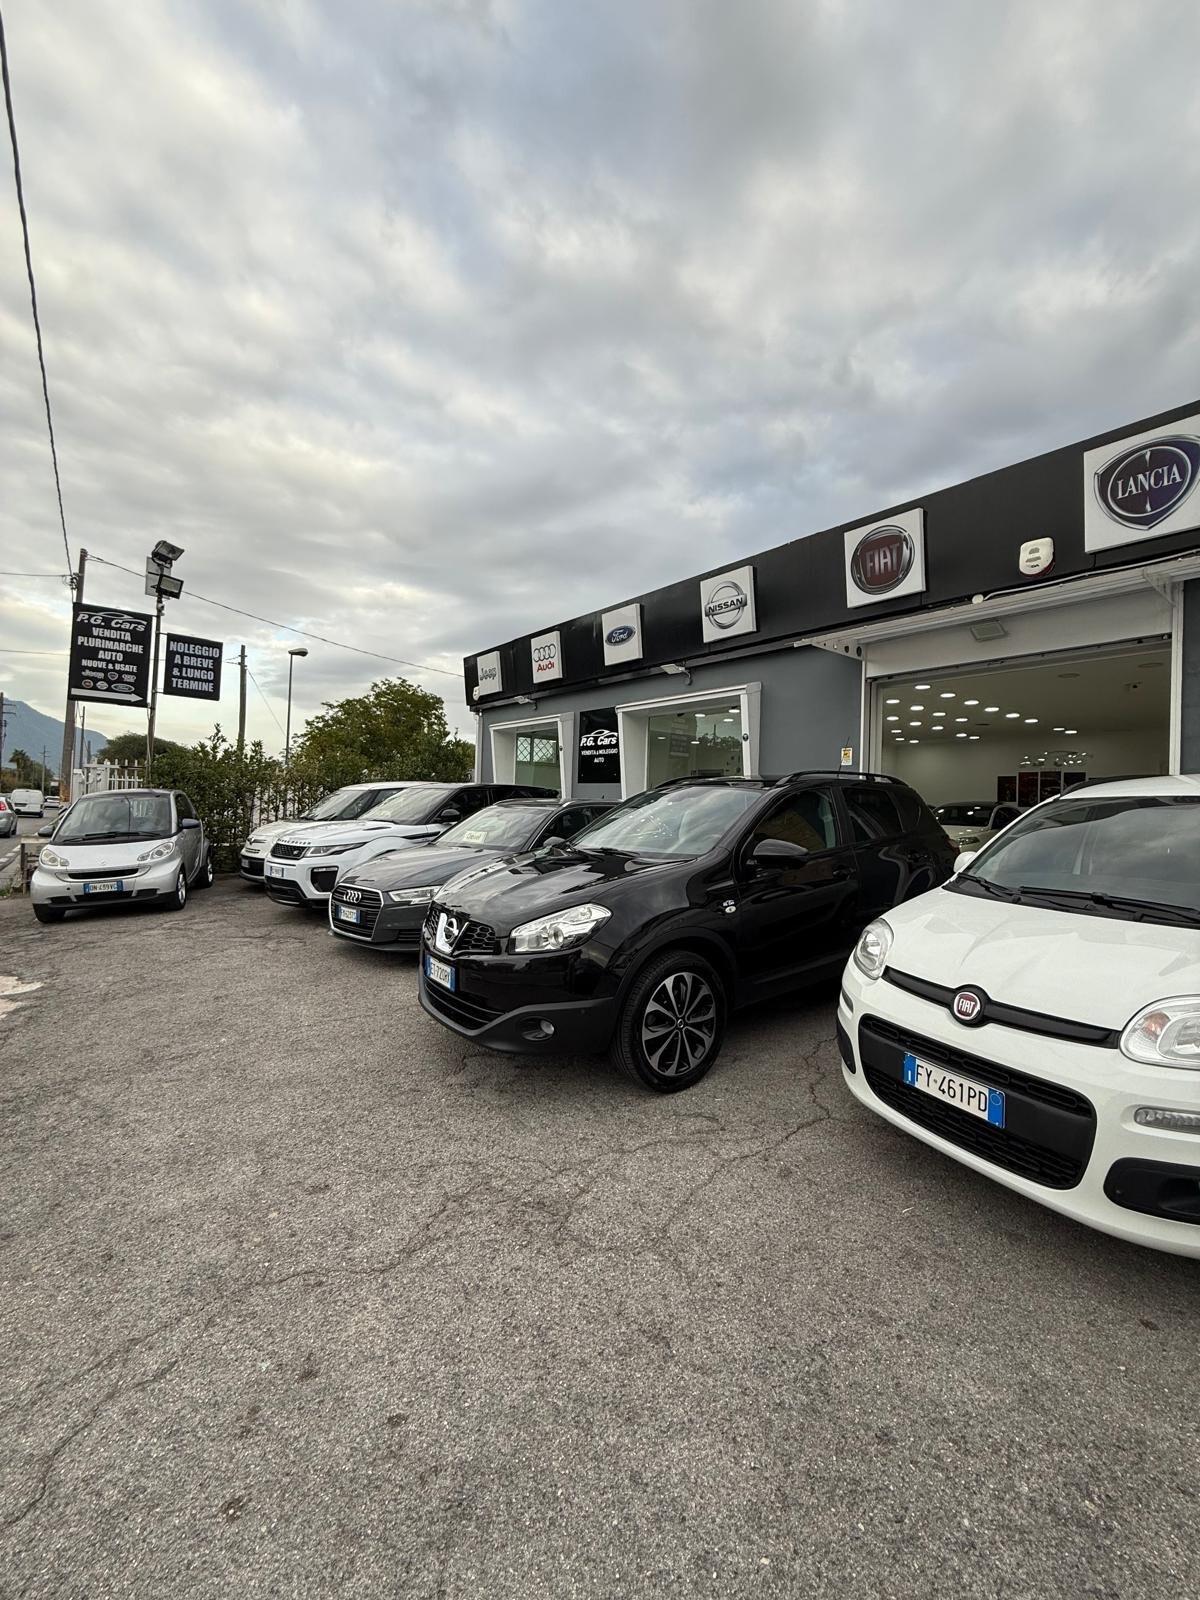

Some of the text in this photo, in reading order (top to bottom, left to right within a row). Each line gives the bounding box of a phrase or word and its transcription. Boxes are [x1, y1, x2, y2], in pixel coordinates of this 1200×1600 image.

[1115, 463, 1183, 499] LANCIA
[865, 542, 900, 577] FIAT
[708, 597, 743, 613] NISSAN
[76, 613, 146, 631] P.G. Cars
[92, 627, 131, 641] VENDITA
[611, 630, 629, 642] Ford
[78, 635, 144, 654] PLURIMARCHE
[169, 641, 220, 657] NOLEGGIO
[98, 650, 123, 662] AUTO
[174, 654, 214, 669] A BREVE
[81, 659, 107, 669] NUOVE
[115, 663, 138, 673] USATE
[537, 660, 555, 672] Audi
[172, 667, 214, 680] & LUNGO
[171, 677, 214, 692] TERMINE
[580, 736, 617, 747] P.G. Cars
[959, 999, 975, 1013] FIAT
